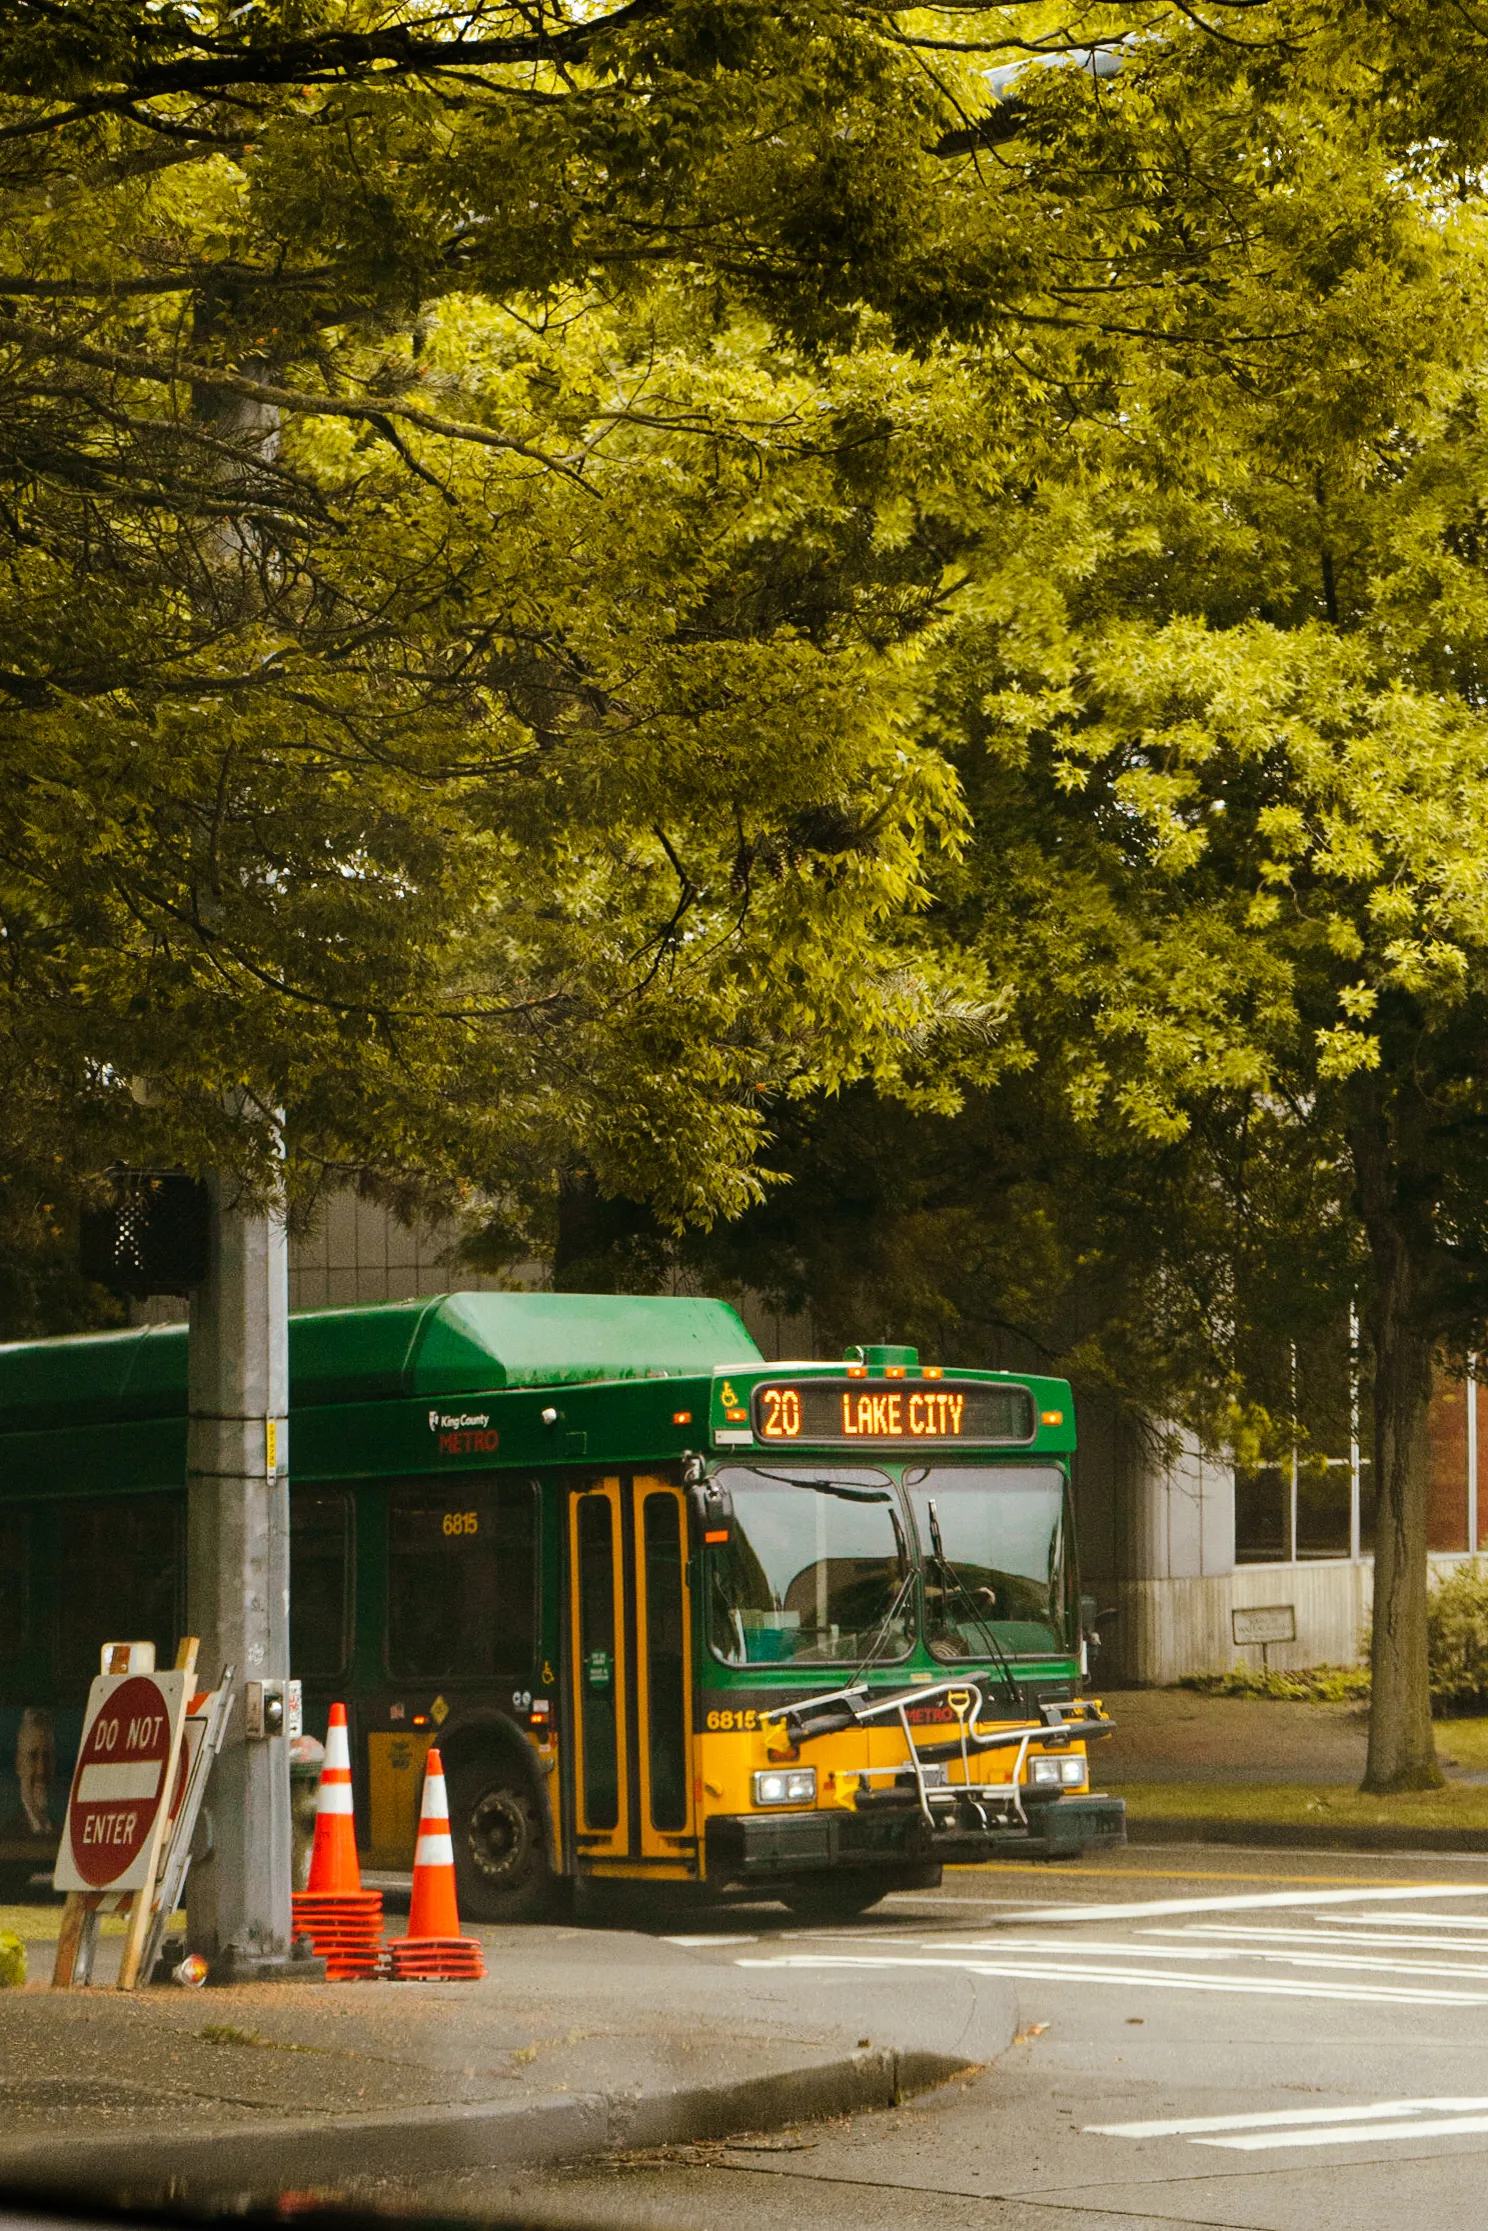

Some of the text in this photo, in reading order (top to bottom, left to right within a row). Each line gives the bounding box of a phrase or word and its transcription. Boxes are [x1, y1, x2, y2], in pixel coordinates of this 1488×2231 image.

[441, 1413, 489, 1430] King County
[764, 1390, 963, 1435] 20 LAKE CITY
[440, 1430, 499, 1454] METRO
[443, 1512, 478, 1536] 6815
[706, 1709, 757, 1730] 6815
[94, 1716, 164, 1751] DO NOT
[82, 1812, 137, 1844] ENTER
